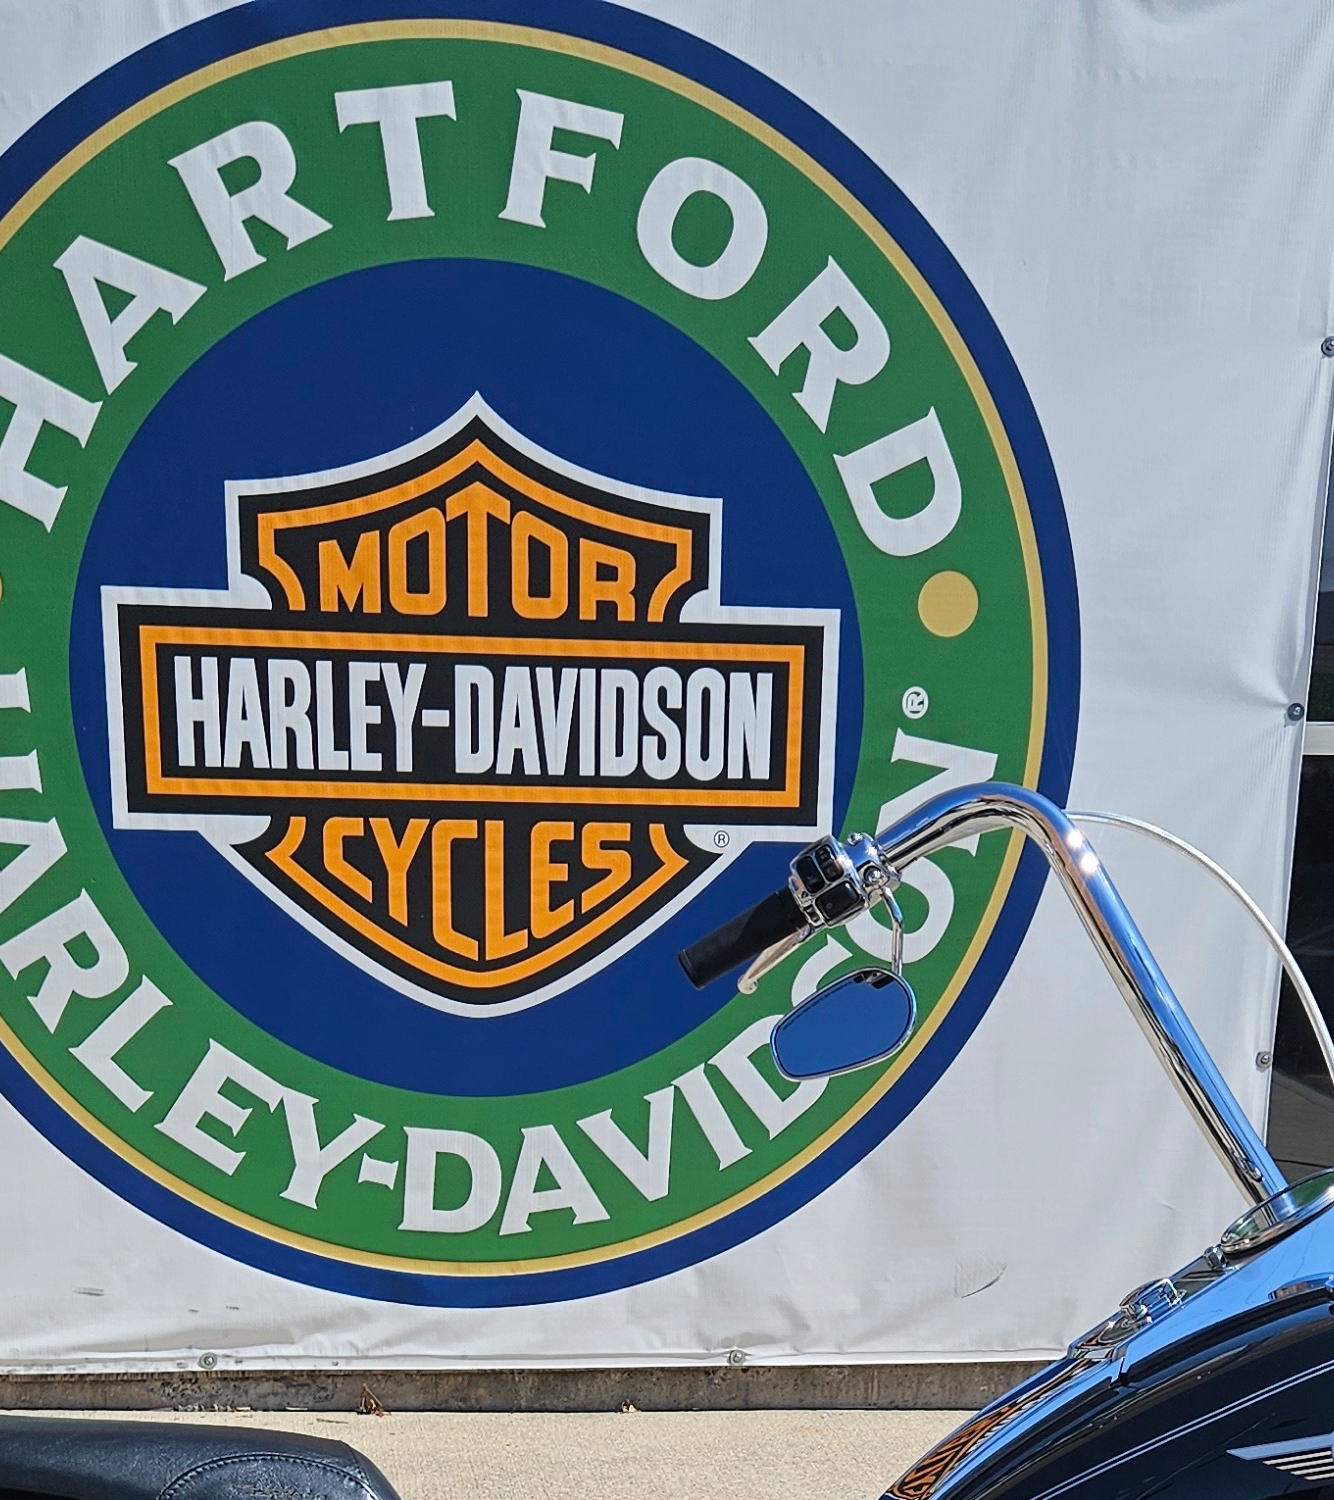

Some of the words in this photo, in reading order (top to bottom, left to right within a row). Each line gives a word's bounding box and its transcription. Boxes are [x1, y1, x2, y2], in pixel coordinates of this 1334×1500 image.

[319, 480, 640, 622] MOTOR
[173, 655, 773, 780] HARLEY-DAVIDSON
[323, 818, 632, 957] CYCLES
